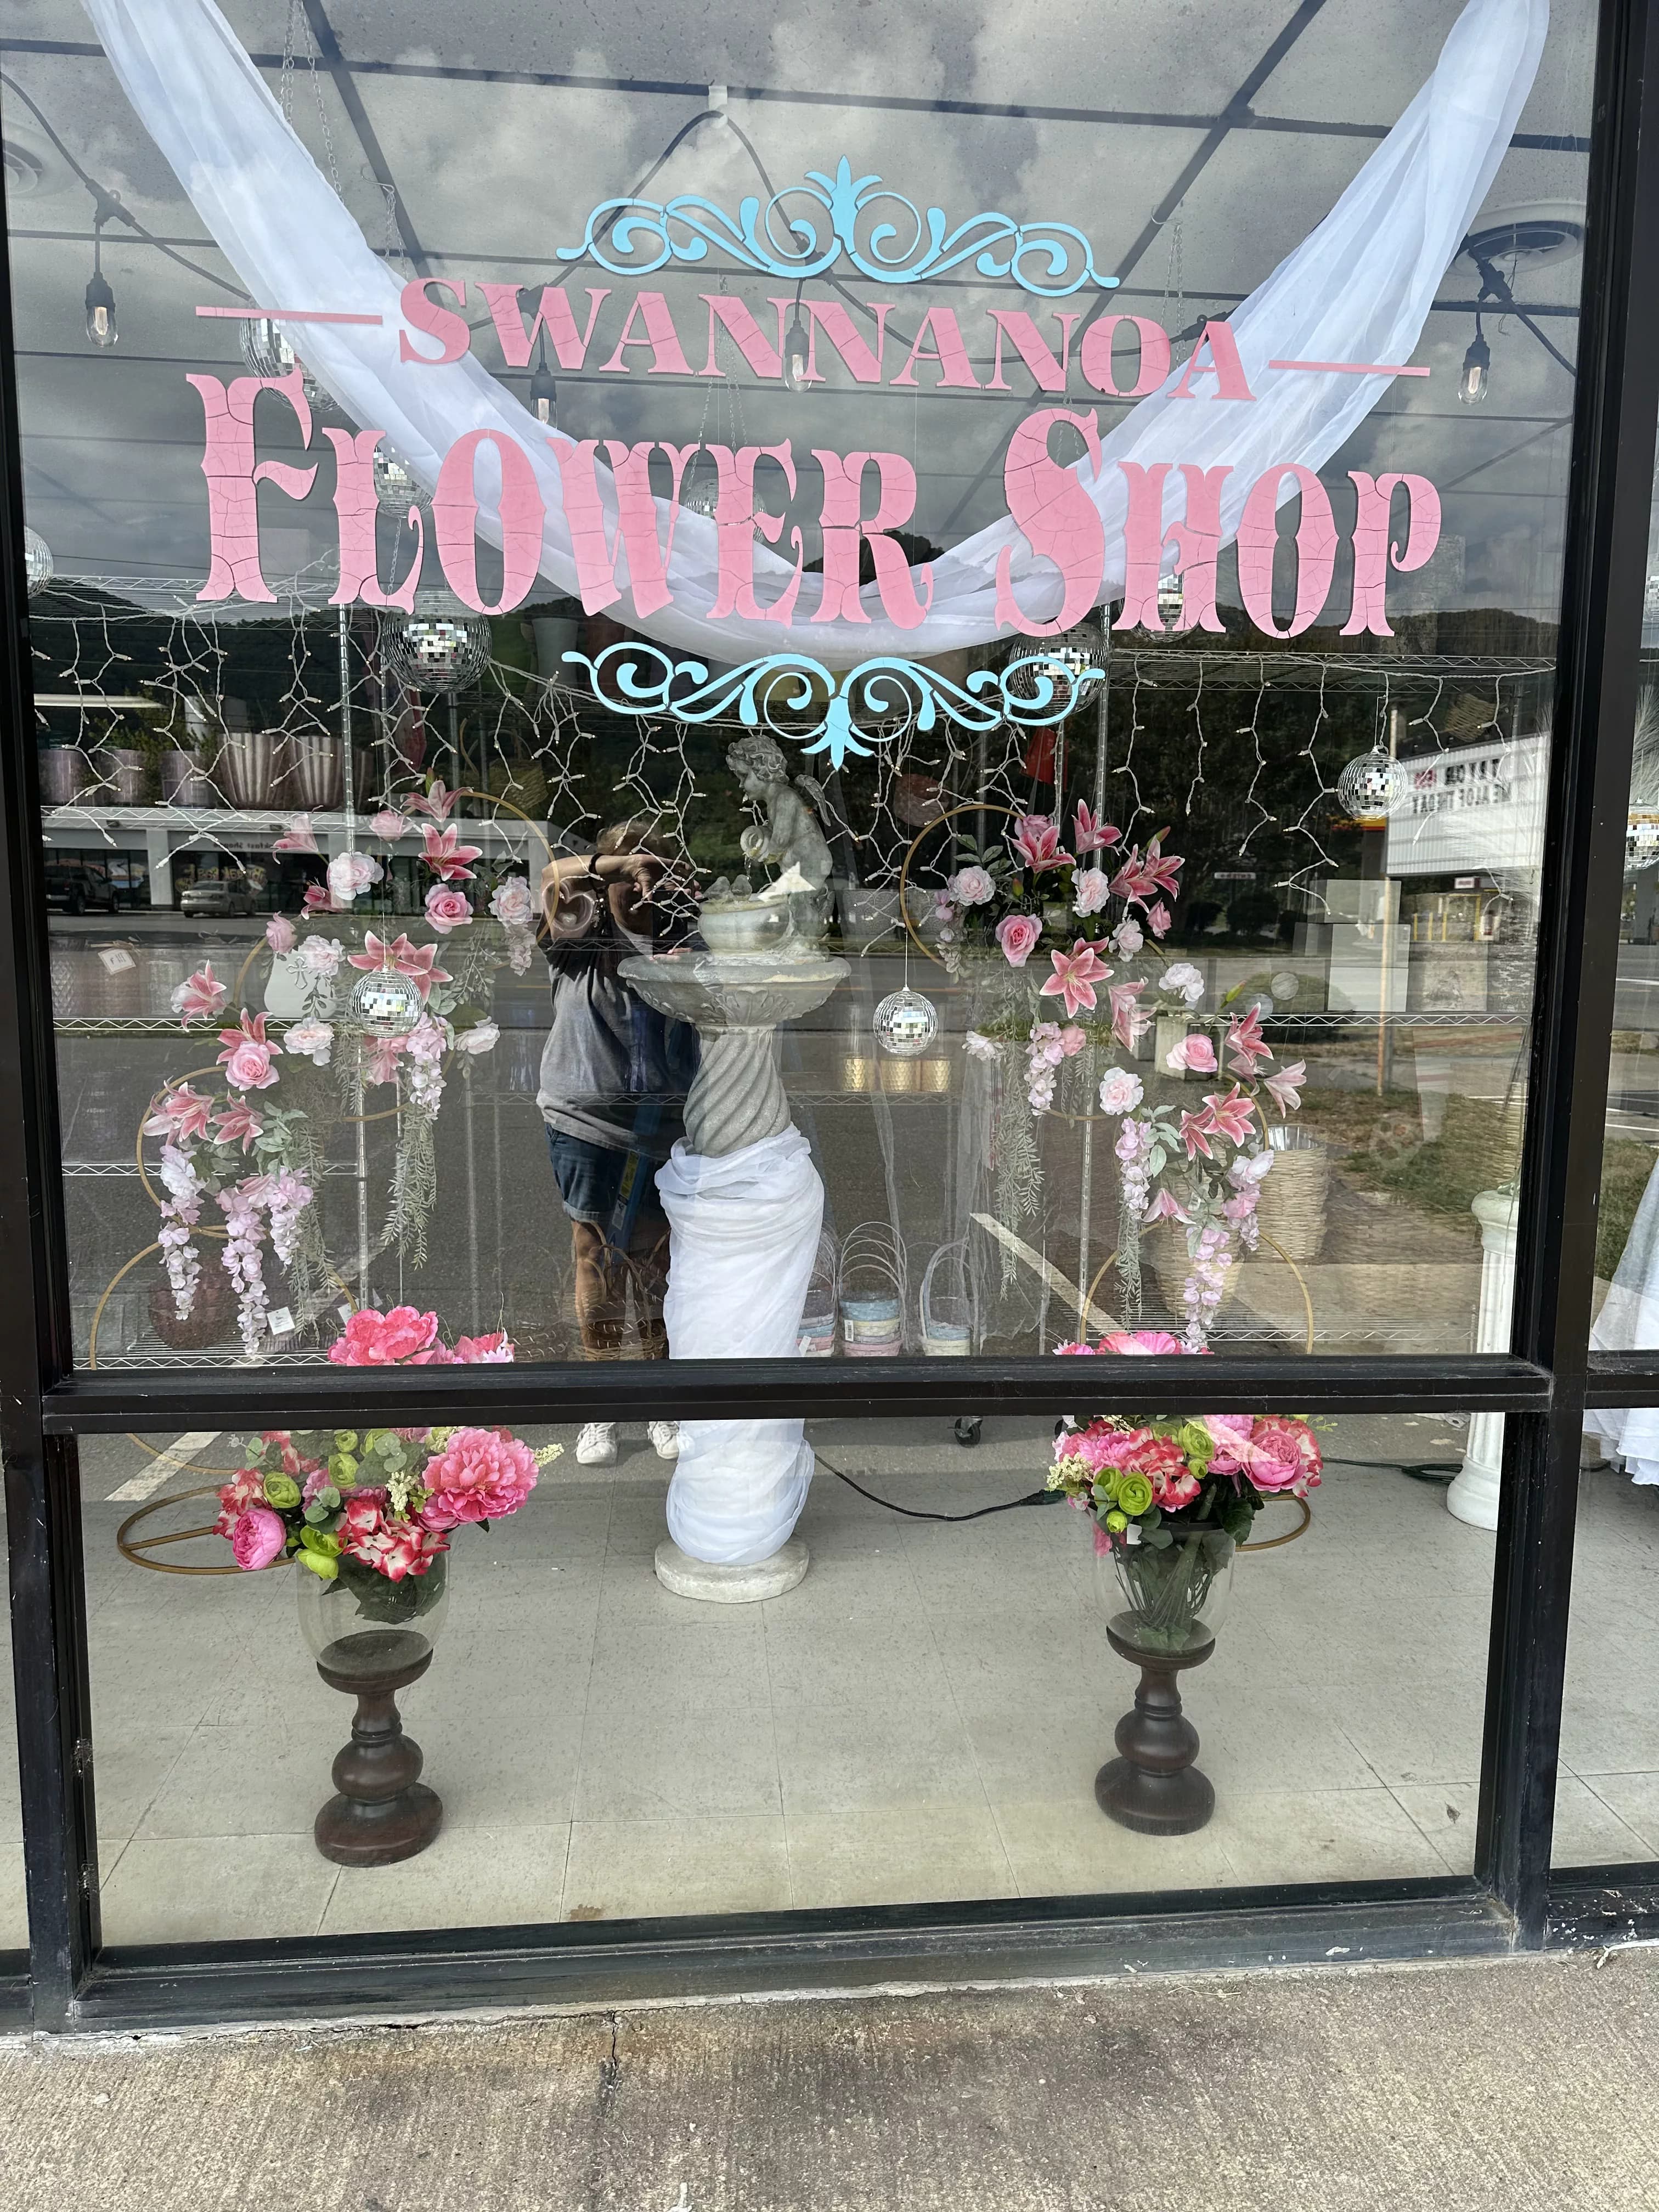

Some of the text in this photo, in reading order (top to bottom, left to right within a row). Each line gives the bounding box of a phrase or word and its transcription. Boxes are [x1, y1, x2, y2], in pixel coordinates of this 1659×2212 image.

[399, 277, 1256, 401] SWANNANOA
[185, 368, 1442, 640] FLOWER SHOP
